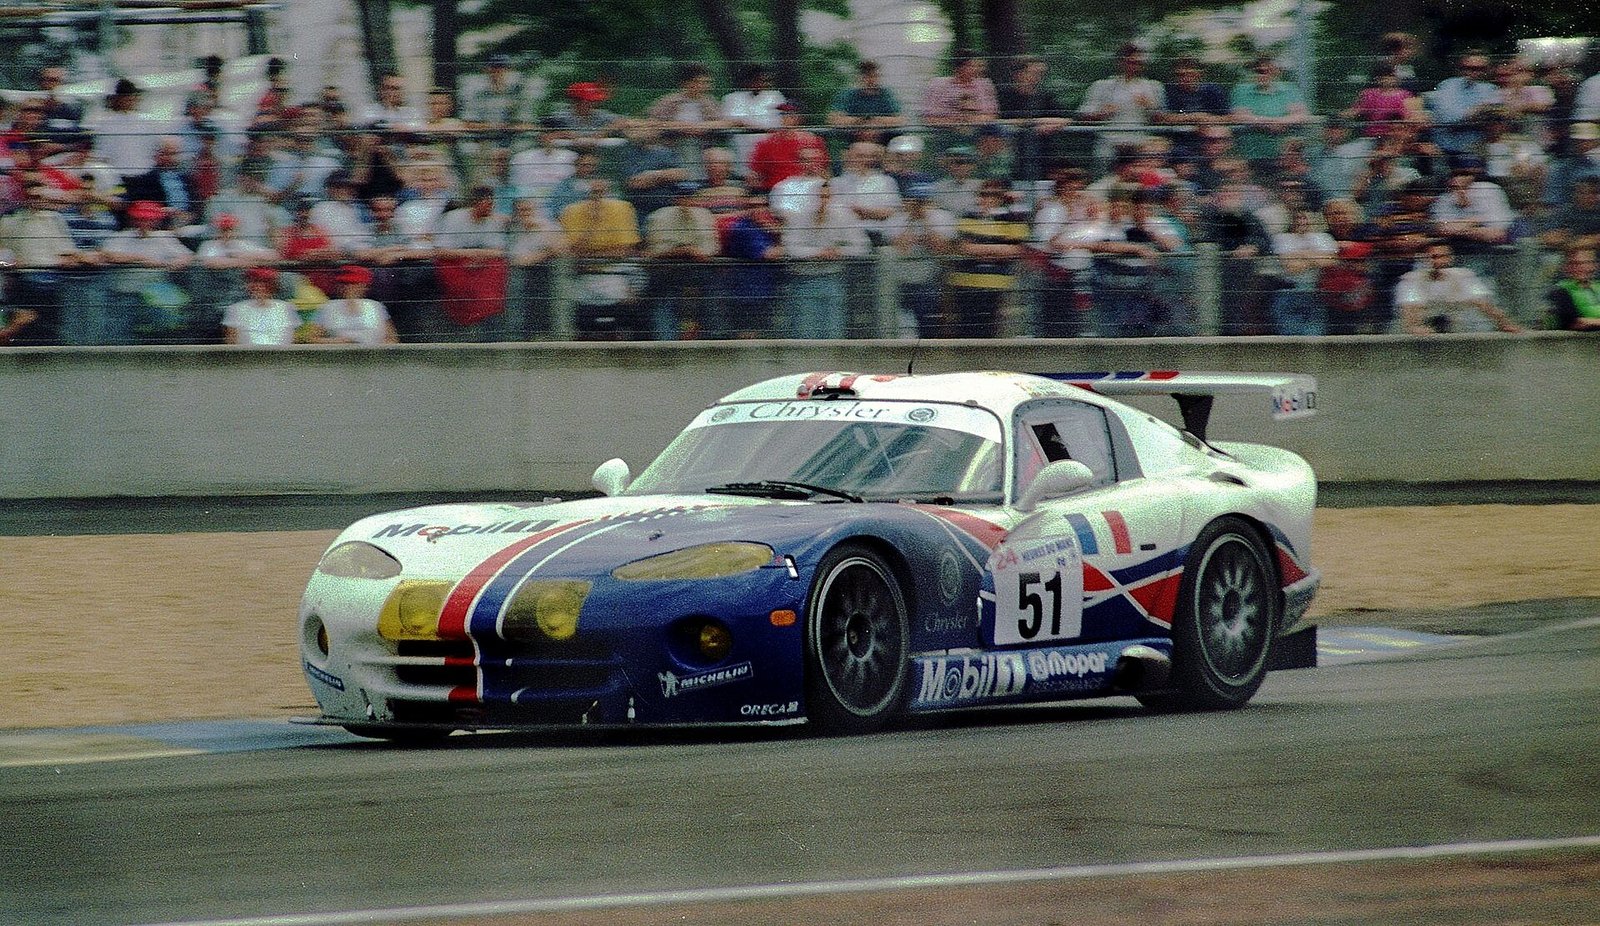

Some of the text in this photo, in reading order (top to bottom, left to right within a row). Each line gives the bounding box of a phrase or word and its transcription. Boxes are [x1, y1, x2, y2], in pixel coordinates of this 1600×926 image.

[750, 401, 890, 419] Chrysler
[372, 519, 514, 540] Mobil
[996, 549, 1019, 571] 24
[1018, 571, 1062, 640] 51
[924, 611, 968, 633] Chrysler
[1047, 651, 1109, 678] Mopar
[680, 666, 749, 689] MICHELIN
[918, 655, 995, 701] Mobil
[740, 704, 786, 716] ORECA
